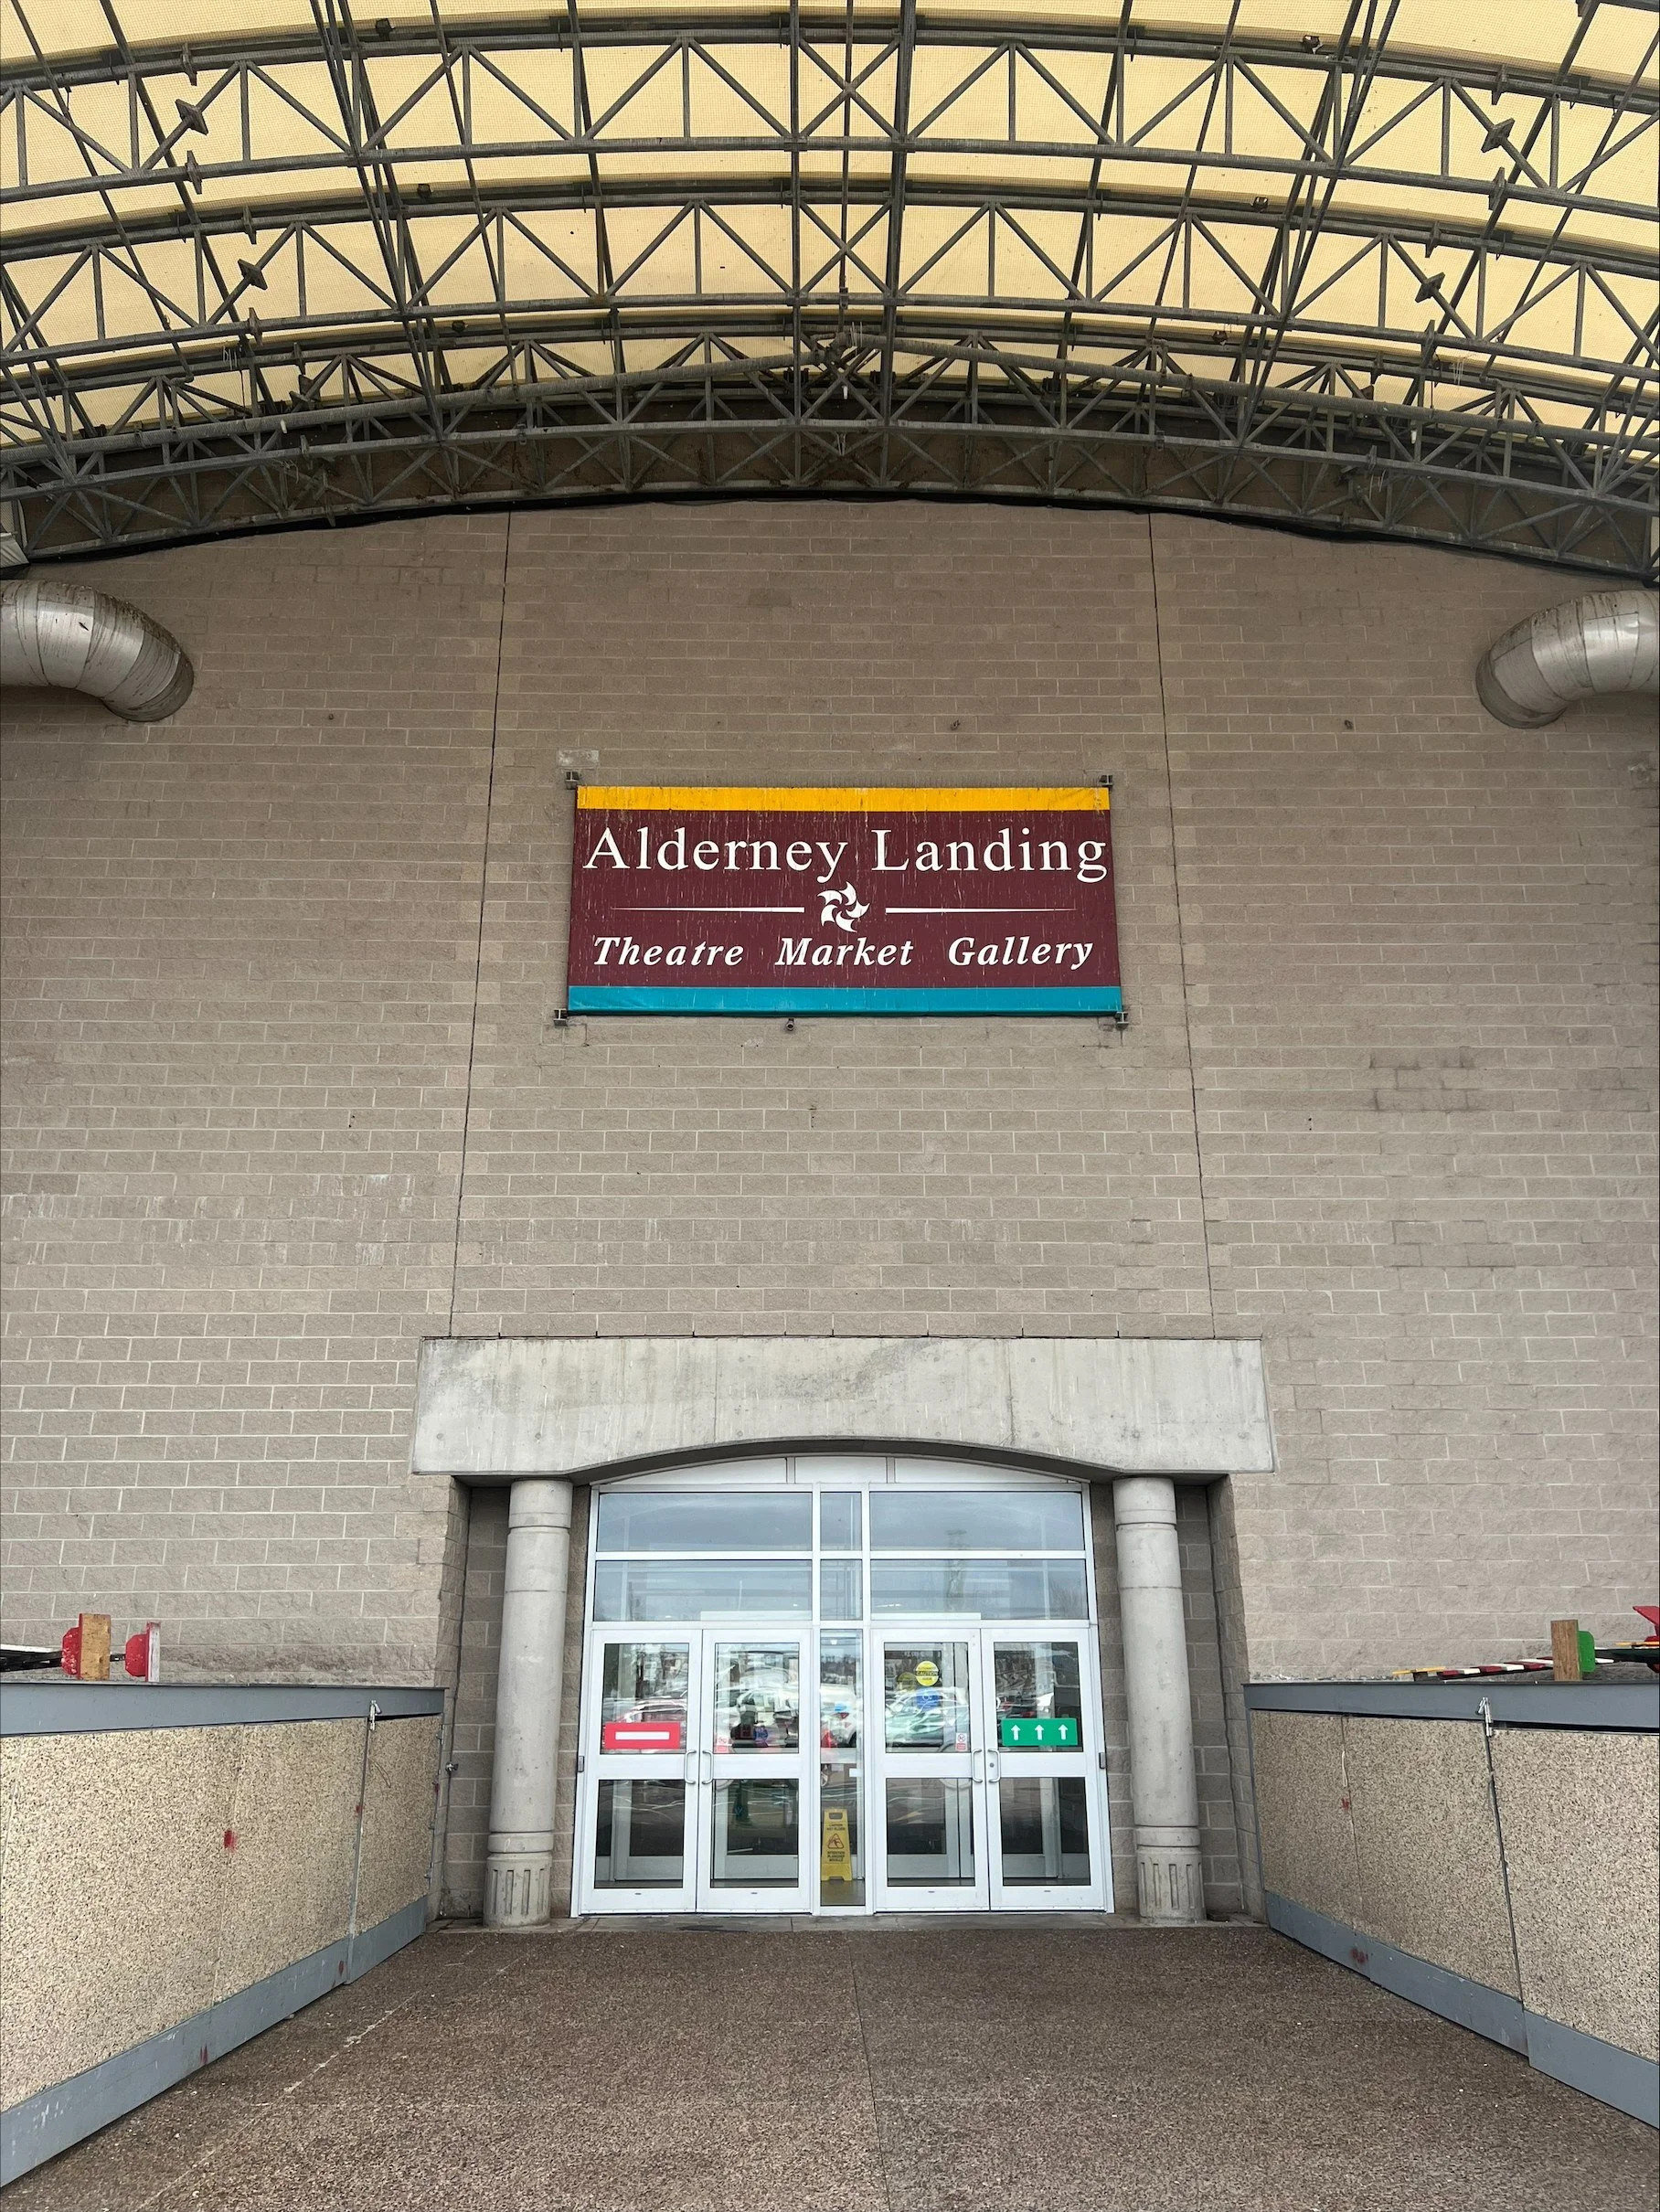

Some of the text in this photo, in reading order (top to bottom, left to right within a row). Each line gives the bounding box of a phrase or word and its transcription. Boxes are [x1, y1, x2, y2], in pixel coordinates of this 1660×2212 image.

[583, 827, 1107, 883] Alderney Landing
[594, 936, 1093, 970] Theatre Market Gallery
